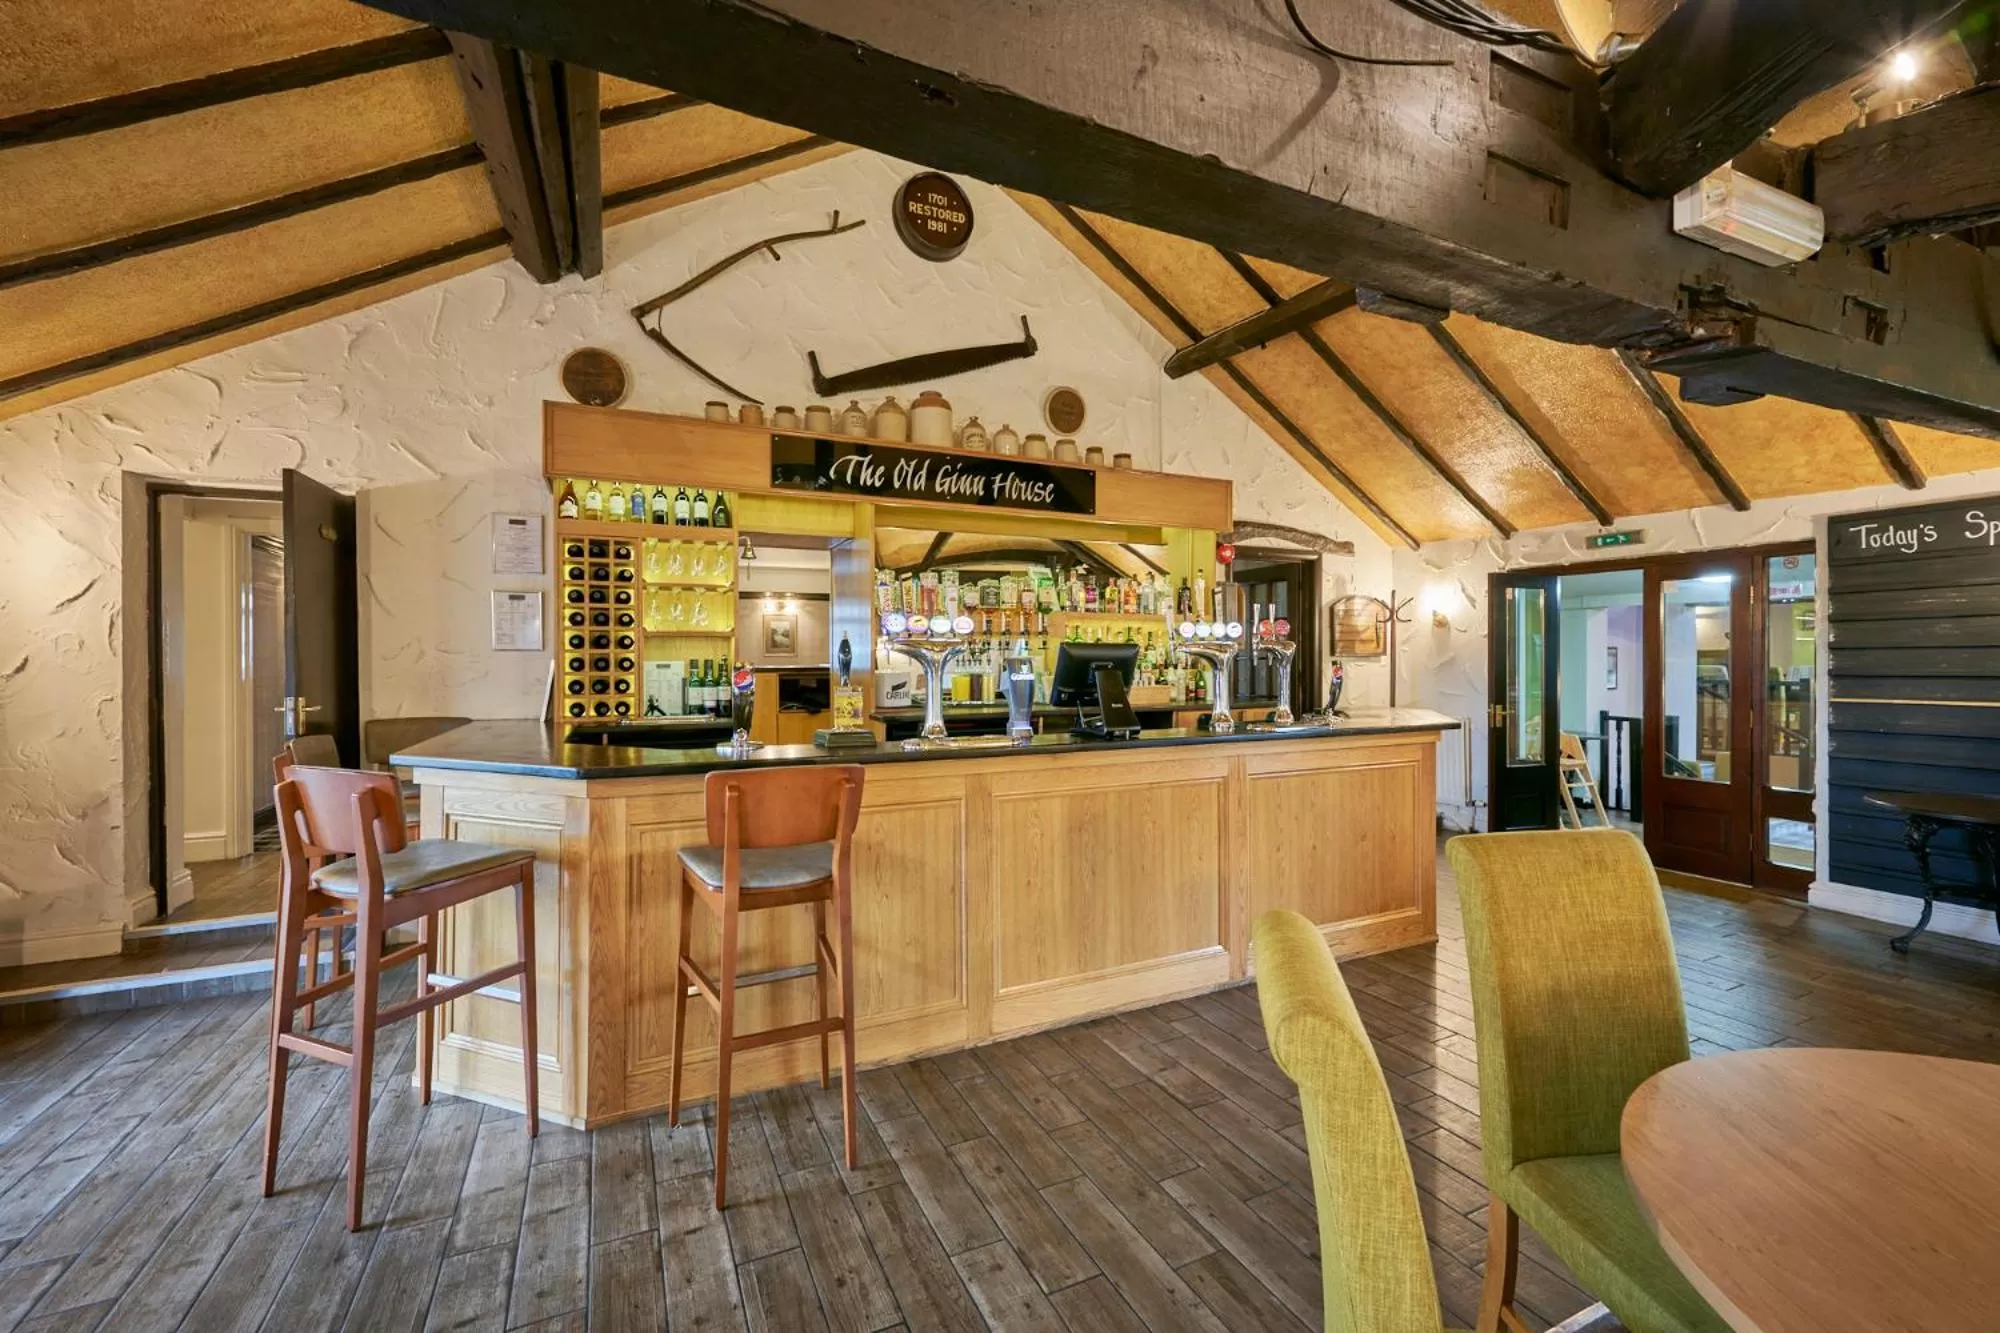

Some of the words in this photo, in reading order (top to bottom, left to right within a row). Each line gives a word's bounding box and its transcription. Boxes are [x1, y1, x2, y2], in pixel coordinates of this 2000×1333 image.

[928, 192, 948, 207] 1701
[908, 201, 966, 224] RESTORED
[927, 218, 947, 234] 1981
[829, 453, 886, 487] The
[893, 457, 932, 492] Old
[935, 462, 985, 498] Ginn
[991, 472, 1055, 503] House
[1849, 524, 1938, 553] Today's
